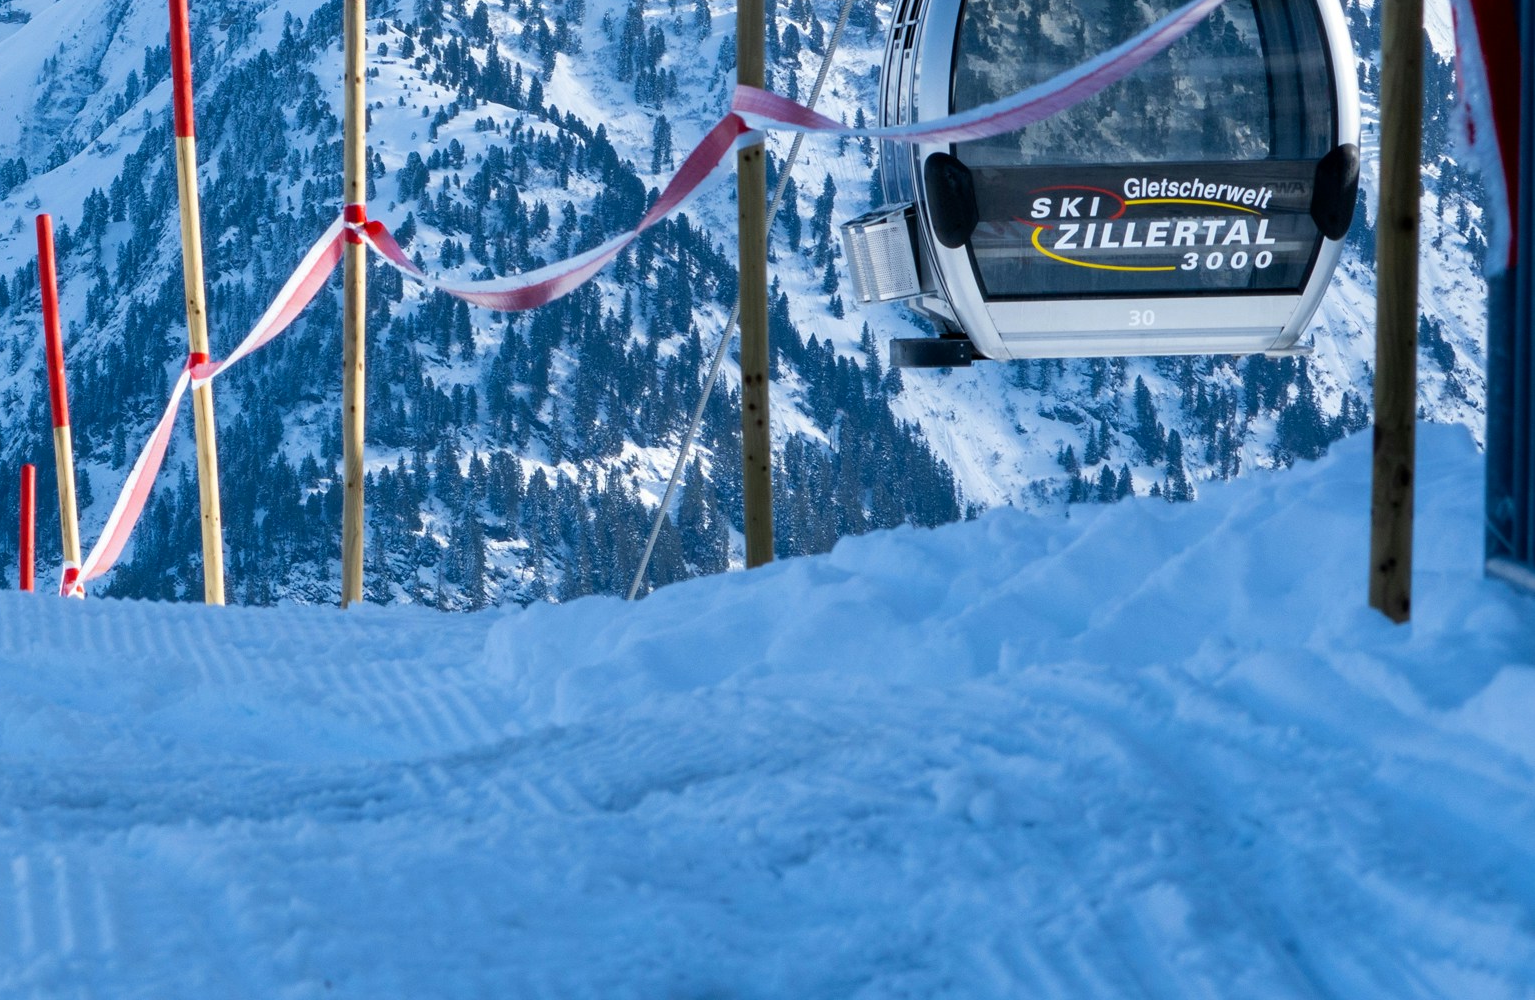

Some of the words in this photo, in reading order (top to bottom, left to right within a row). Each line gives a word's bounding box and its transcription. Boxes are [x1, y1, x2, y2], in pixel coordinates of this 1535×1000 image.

[1123, 178, 1273, 209] Gletscherwelt
[1031, 197, 1101, 219] SKI
[1054, 219, 1276, 250] ZILLERTAL
[1180, 250, 1273, 270] 3000
[1128, 310, 1155, 327] 30
